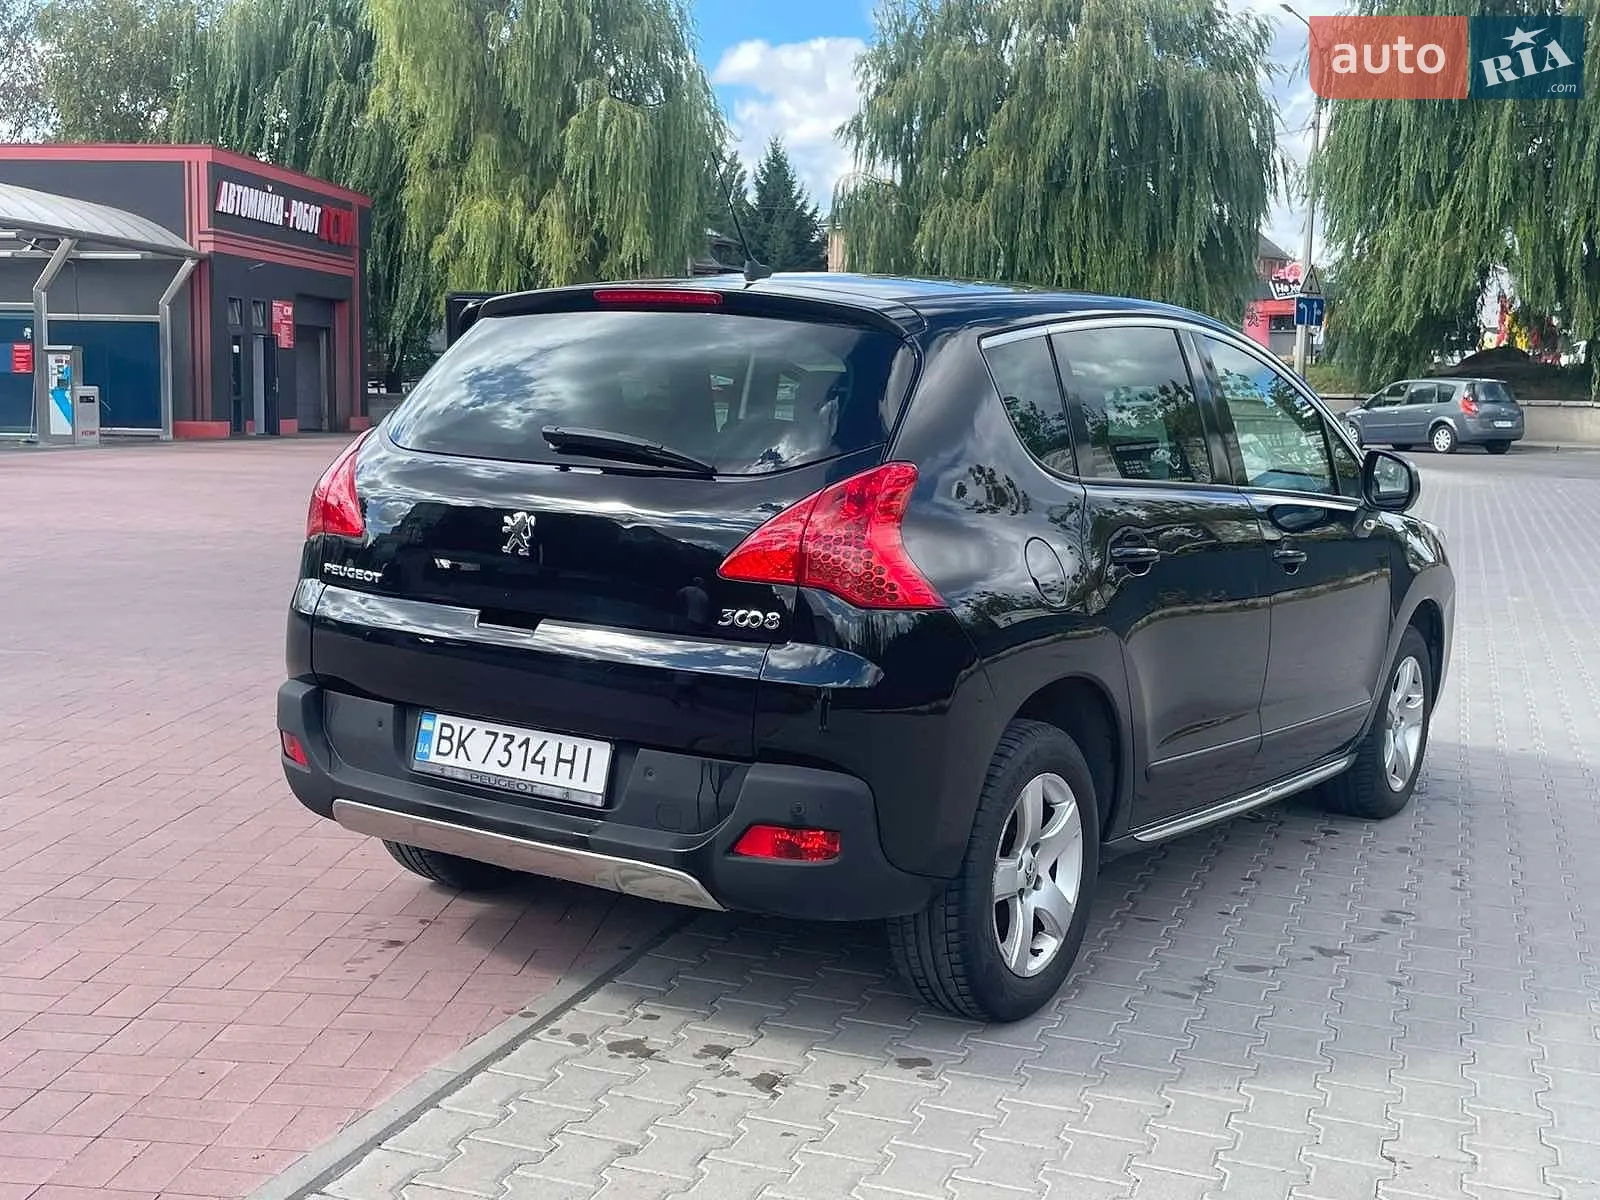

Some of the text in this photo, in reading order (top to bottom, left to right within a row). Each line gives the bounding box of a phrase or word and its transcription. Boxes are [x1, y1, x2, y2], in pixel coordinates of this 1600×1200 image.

[324, 562, 383, 584] PEUGEOT
[717, 608, 781, 630] 3008
[417, 743, 430, 753] UA
[435, 722, 477, 762] BK
[470, 773, 537, 793] PEUGEOT
